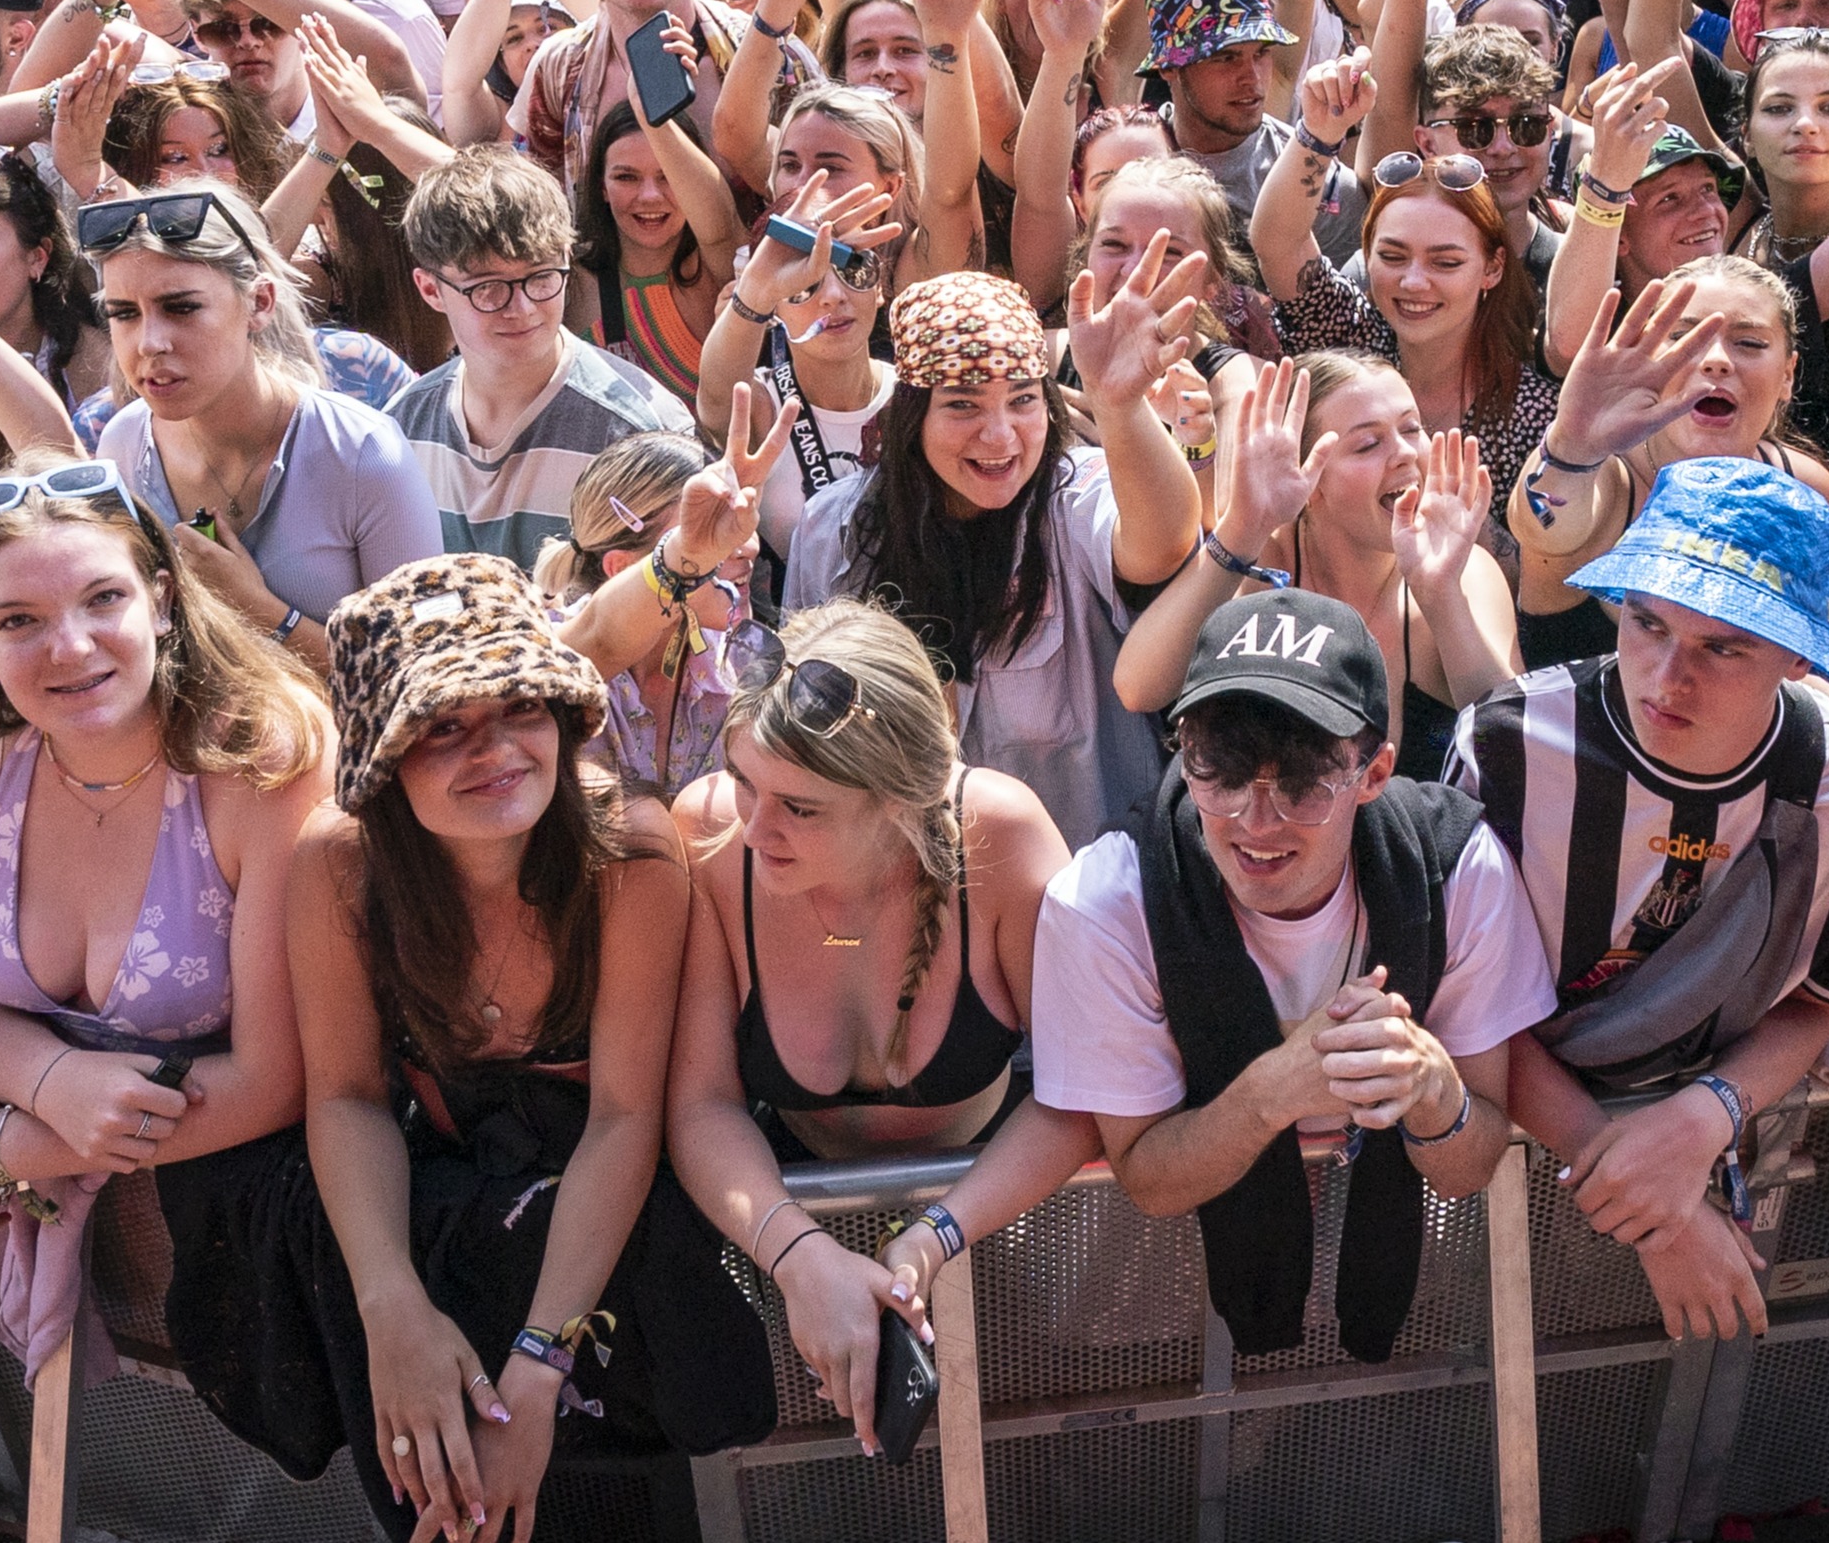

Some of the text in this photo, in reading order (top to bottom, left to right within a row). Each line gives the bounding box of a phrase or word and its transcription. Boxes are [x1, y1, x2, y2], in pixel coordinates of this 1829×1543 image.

[1661, 531, 1784, 594] IKEA
[1215, 612, 1335, 668] AM
[1648, 833, 1731, 862] adidas
[822, 934, 863, 947] Lauren
